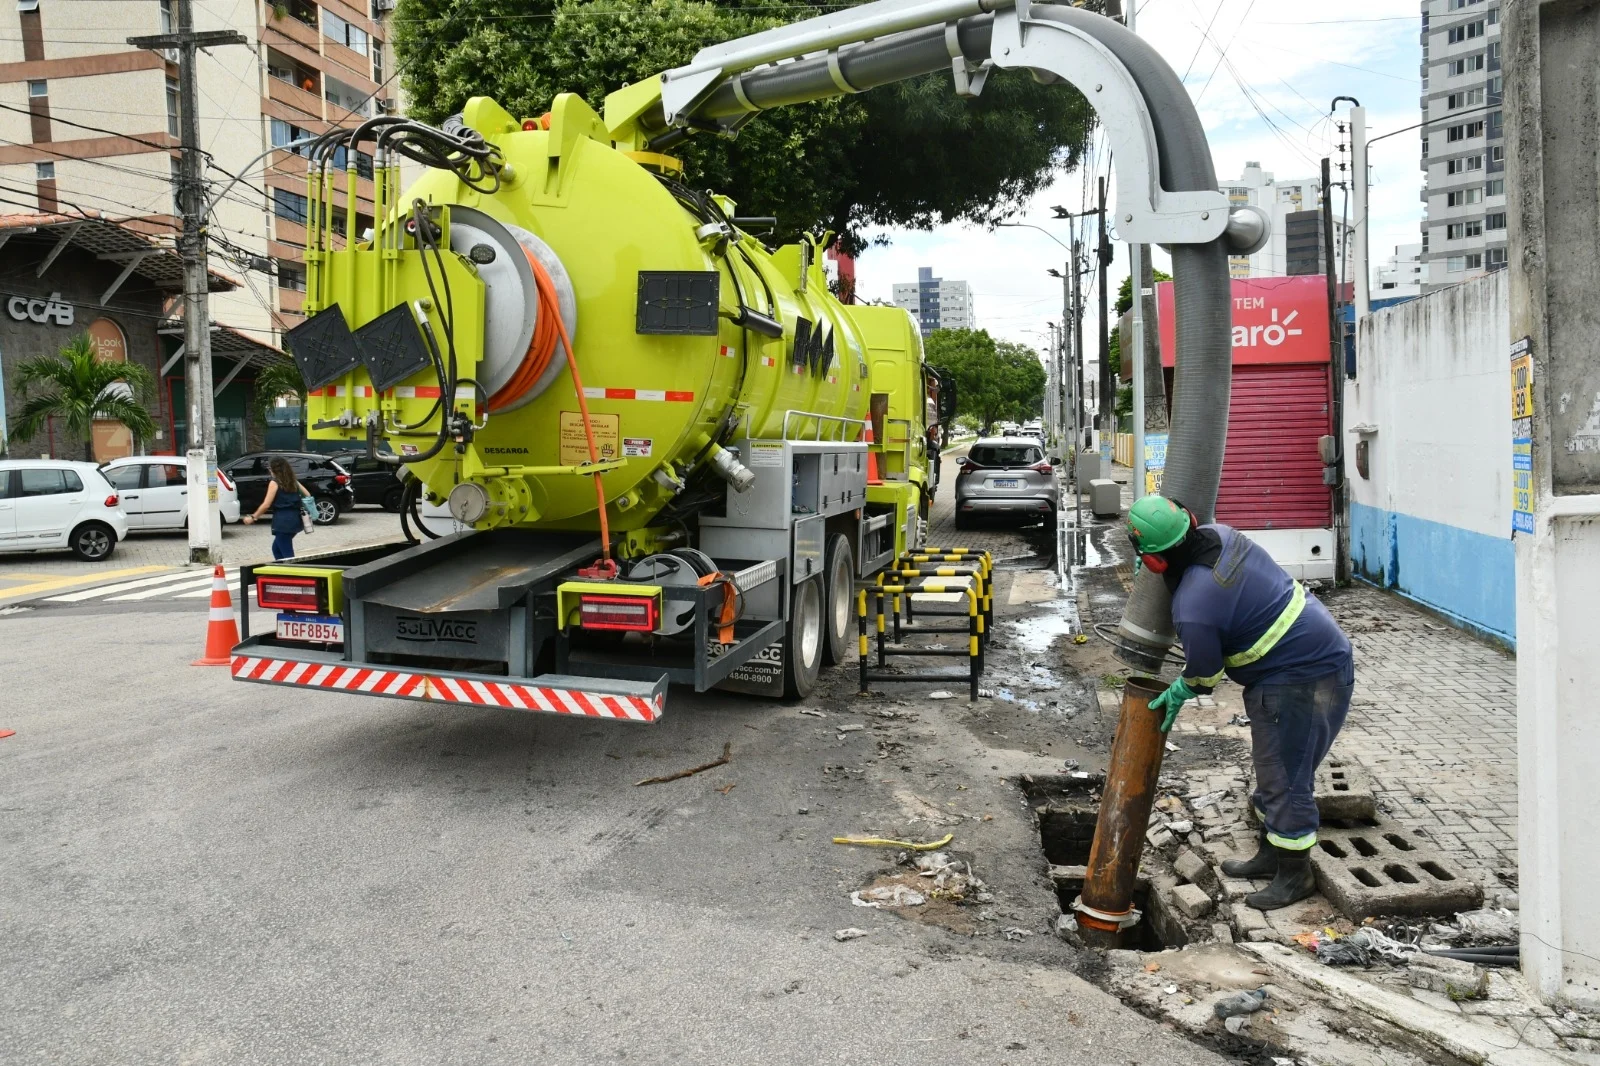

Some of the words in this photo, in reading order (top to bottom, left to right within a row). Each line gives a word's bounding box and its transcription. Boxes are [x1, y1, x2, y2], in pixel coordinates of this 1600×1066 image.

[8, 292, 74, 326] CCAB
[1234, 297, 1264, 310] TEM
[97, 336, 122, 348] Look
[1232, 324, 1285, 347] aro
[99, 348, 115, 357] For
[1516, 392, 1526, 416] 99
[1518, 491, 1529, 511] 99
[284, 622, 338, 640] TGF8B54
[729, 672, 772, 683] 4840-8900
